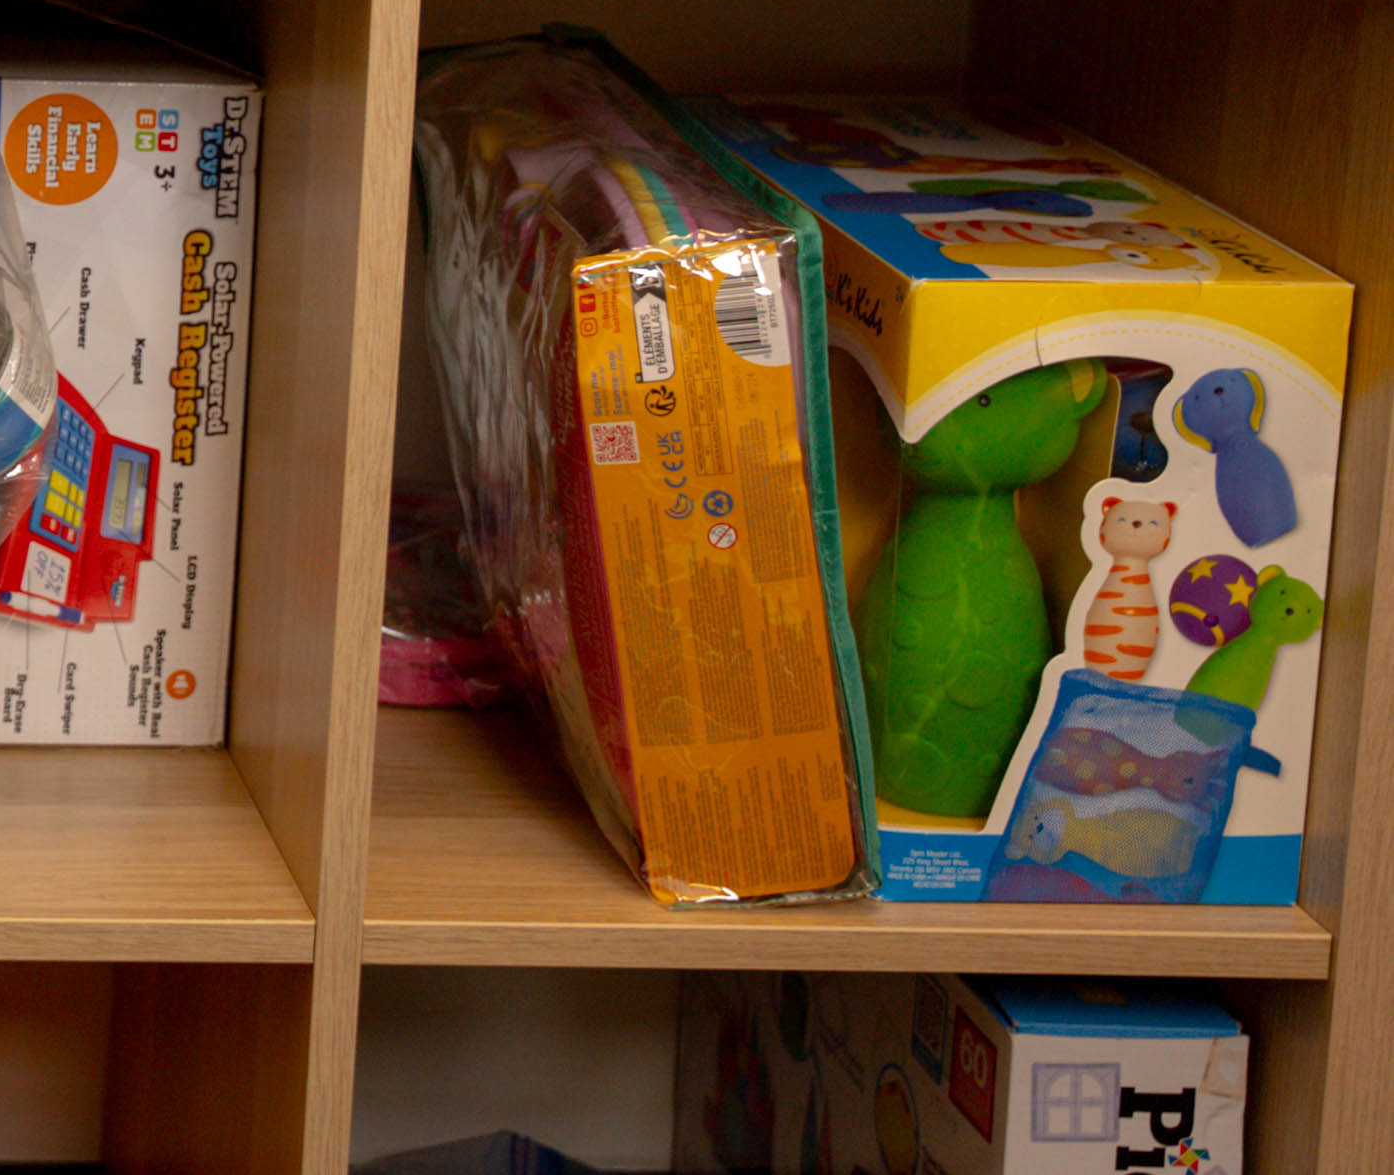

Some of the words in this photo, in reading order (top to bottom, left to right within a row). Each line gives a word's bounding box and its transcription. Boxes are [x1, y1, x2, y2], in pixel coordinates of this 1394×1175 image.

[25, 123, 43, 174] Skills
[45, 105, 63, 188] Financial
[62, 122, 82, 172] Early
[85, 121, 101, 174] Learn
[197, 124, 224, 190] Toys
[153, 165, 176, 192] 3+
[80, 267, 92, 298] Cash
[179, 229, 213, 315] Cash
[77, 301, 90, 350] Drawer
[853, 288, 884, 336] Kids
[131, 338, 146, 385] Keypad
[205, 261, 237, 437] Solar-Powered
[169, 322, 208, 467] Register
[657, 434, 672, 456] UK
[669, 431, 684, 454] CA
[172, 481, 184, 516] Solar
[170, 518, 182, 551] Panel
[186, 555, 198, 581] LCD
[181, 584, 196, 630] Display
[66, 662, 77, 690] Card
[142, 644, 154, 674] Cash
[154, 628, 167, 678] Speaker
[14, 673, 28, 734] Dry-Erase
[127, 664, 140, 707] Sounds
[139, 677, 153, 726] Register
[153, 681, 162, 706] with
[62, 692, 75, 735] Swiper
[150, 708, 162, 739] Real
[926, 849, 948, 857] Master
[961, 1029, 987, 1089] 60
[1114, 1086, 1196, 1175] Pi
